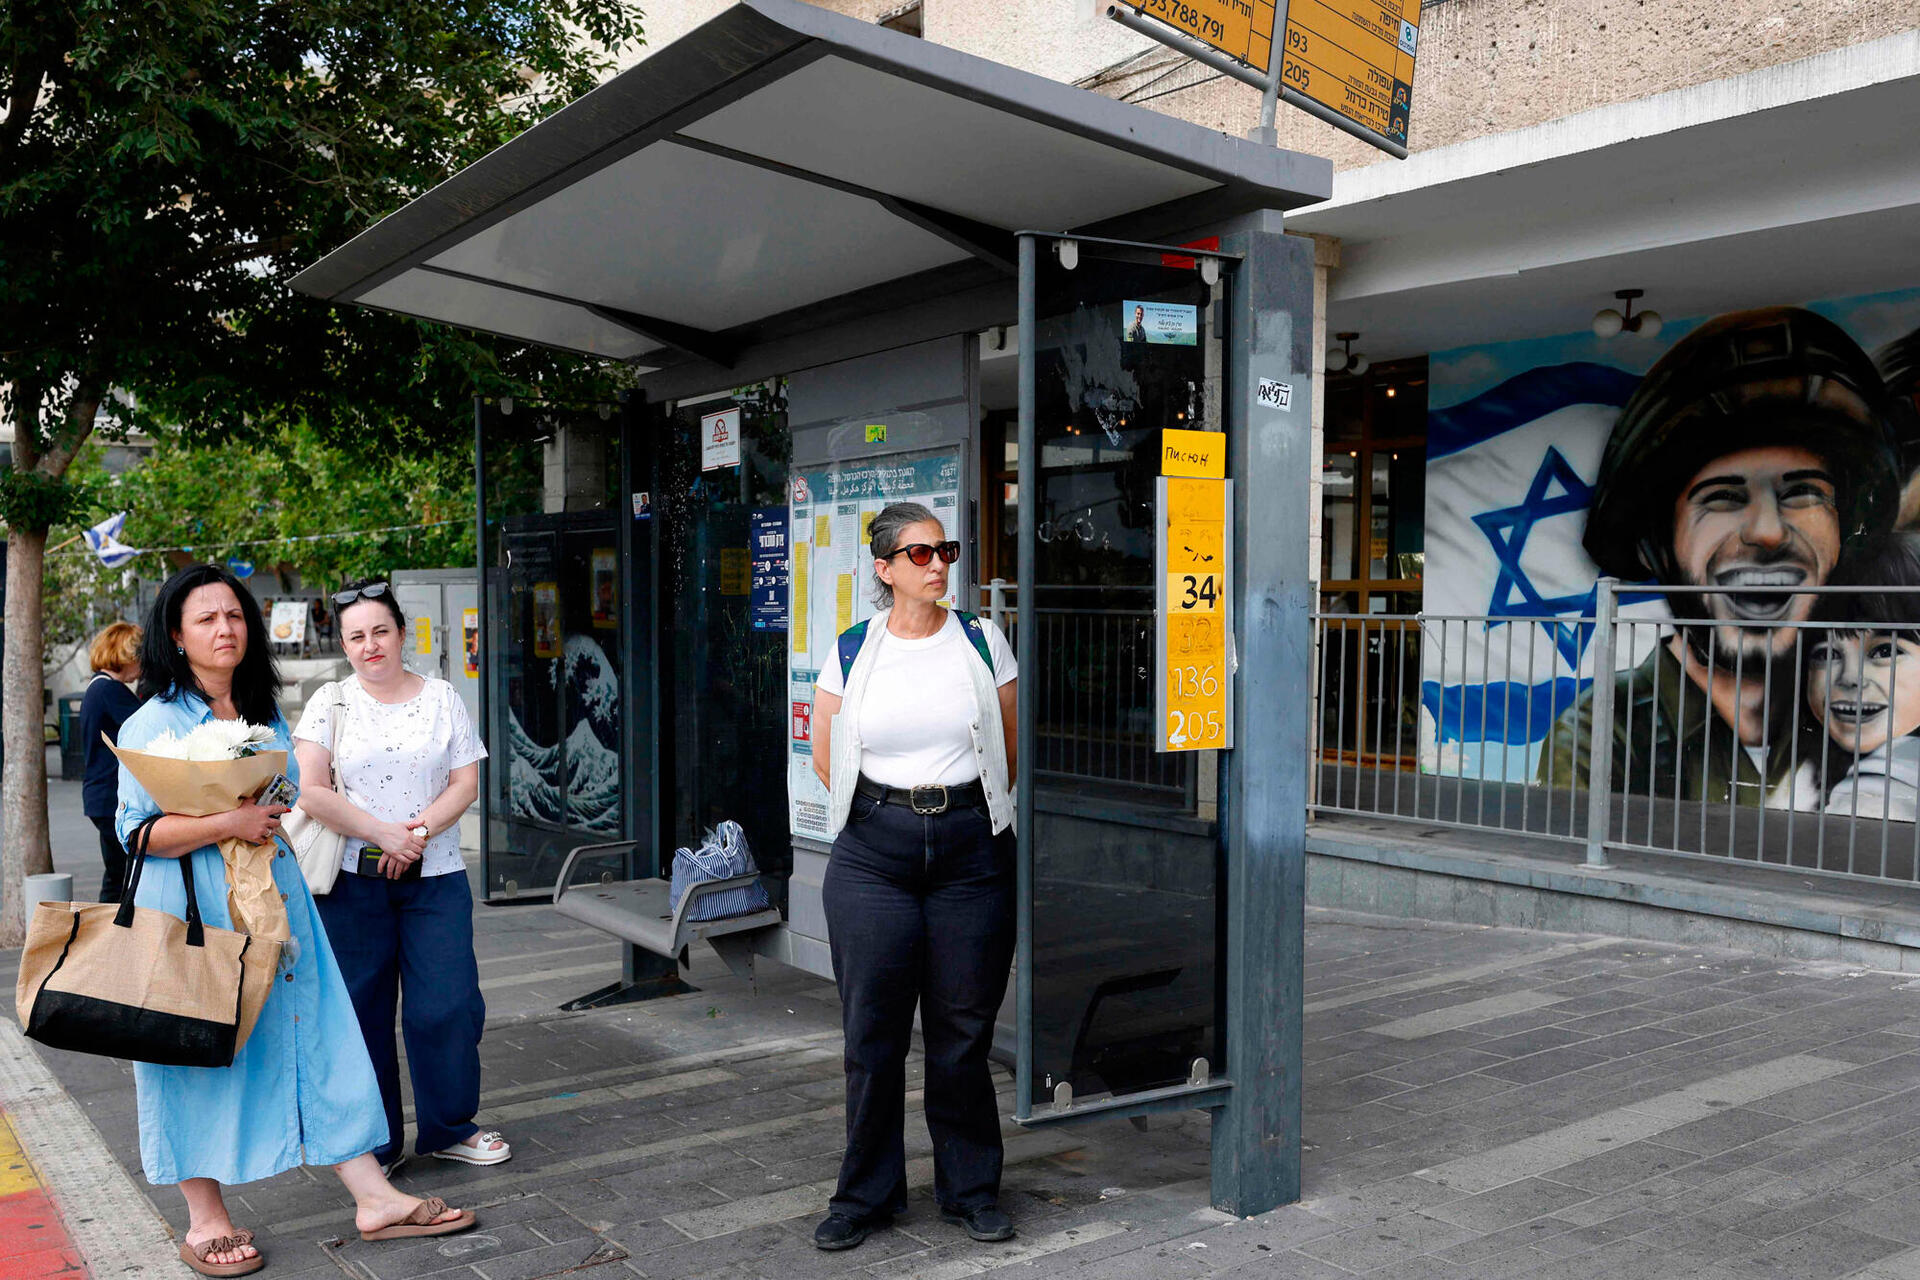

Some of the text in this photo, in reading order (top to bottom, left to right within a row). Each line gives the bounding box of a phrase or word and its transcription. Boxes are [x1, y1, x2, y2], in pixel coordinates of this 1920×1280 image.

[1379, 11, 1399, 32] חיפה
[1288, 28, 1308, 53] 193
[1284, 60, 1310, 87] 205
[1368, 68, 1392, 91] עפולה
[1368, 101, 1389, 121] טירת
[1181, 575, 1217, 609] 34
[1174, 665, 1218, 696] 136
[1169, 710, 1219, 745] 205
